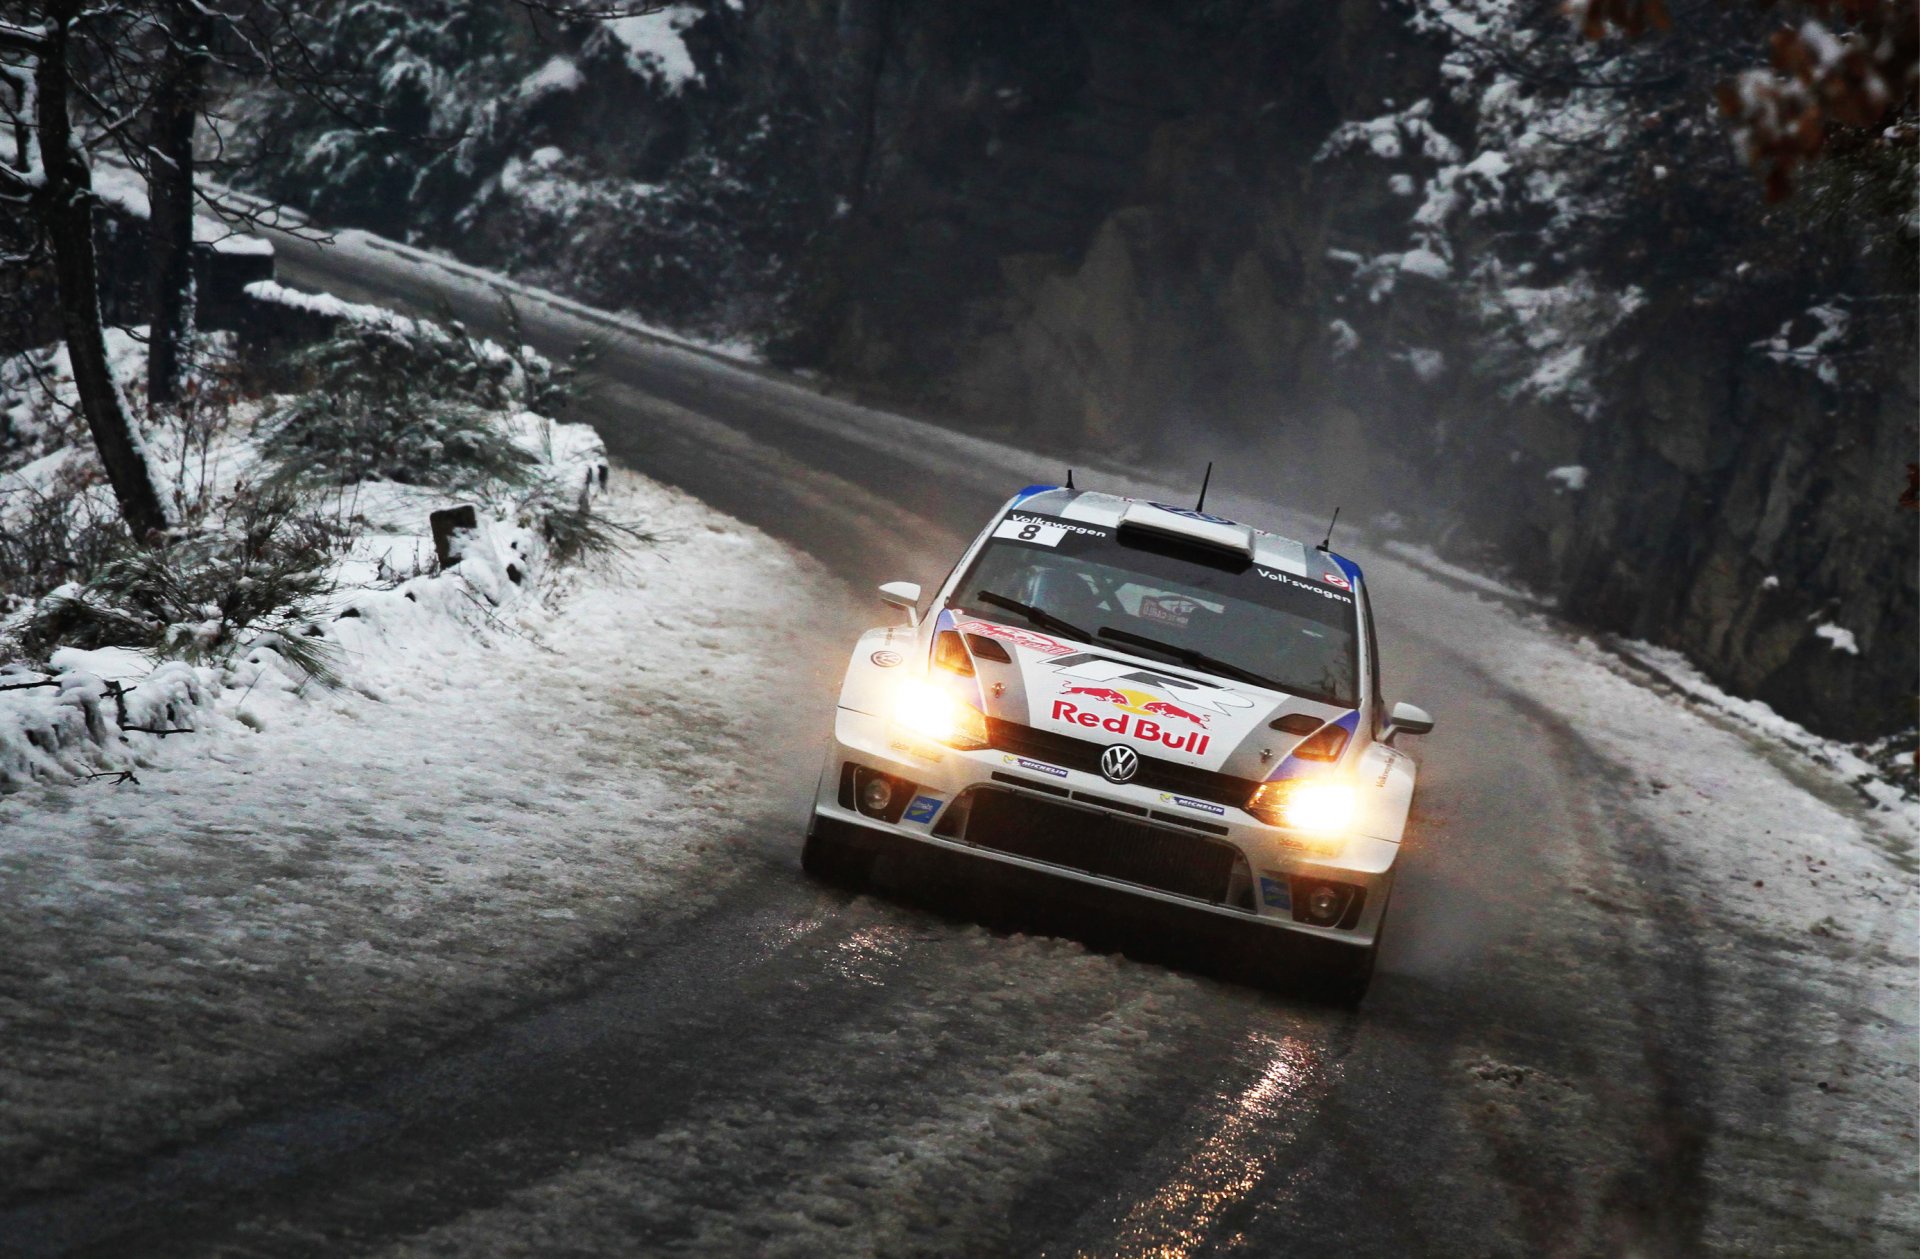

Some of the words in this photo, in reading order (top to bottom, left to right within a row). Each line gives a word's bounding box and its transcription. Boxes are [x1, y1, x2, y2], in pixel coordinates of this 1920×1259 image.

[1012, 514, 1107, 538] Volkswagen
[1018, 524, 1042, 541] 8
[1257, 567, 1352, 604] Volkswagen
[1051, 700, 1130, 735] Red
[1133, 718, 1211, 756] Bull
[1021, 760, 1068, 777] MICHELIN
[1178, 799, 1224, 814] MICHELIN
